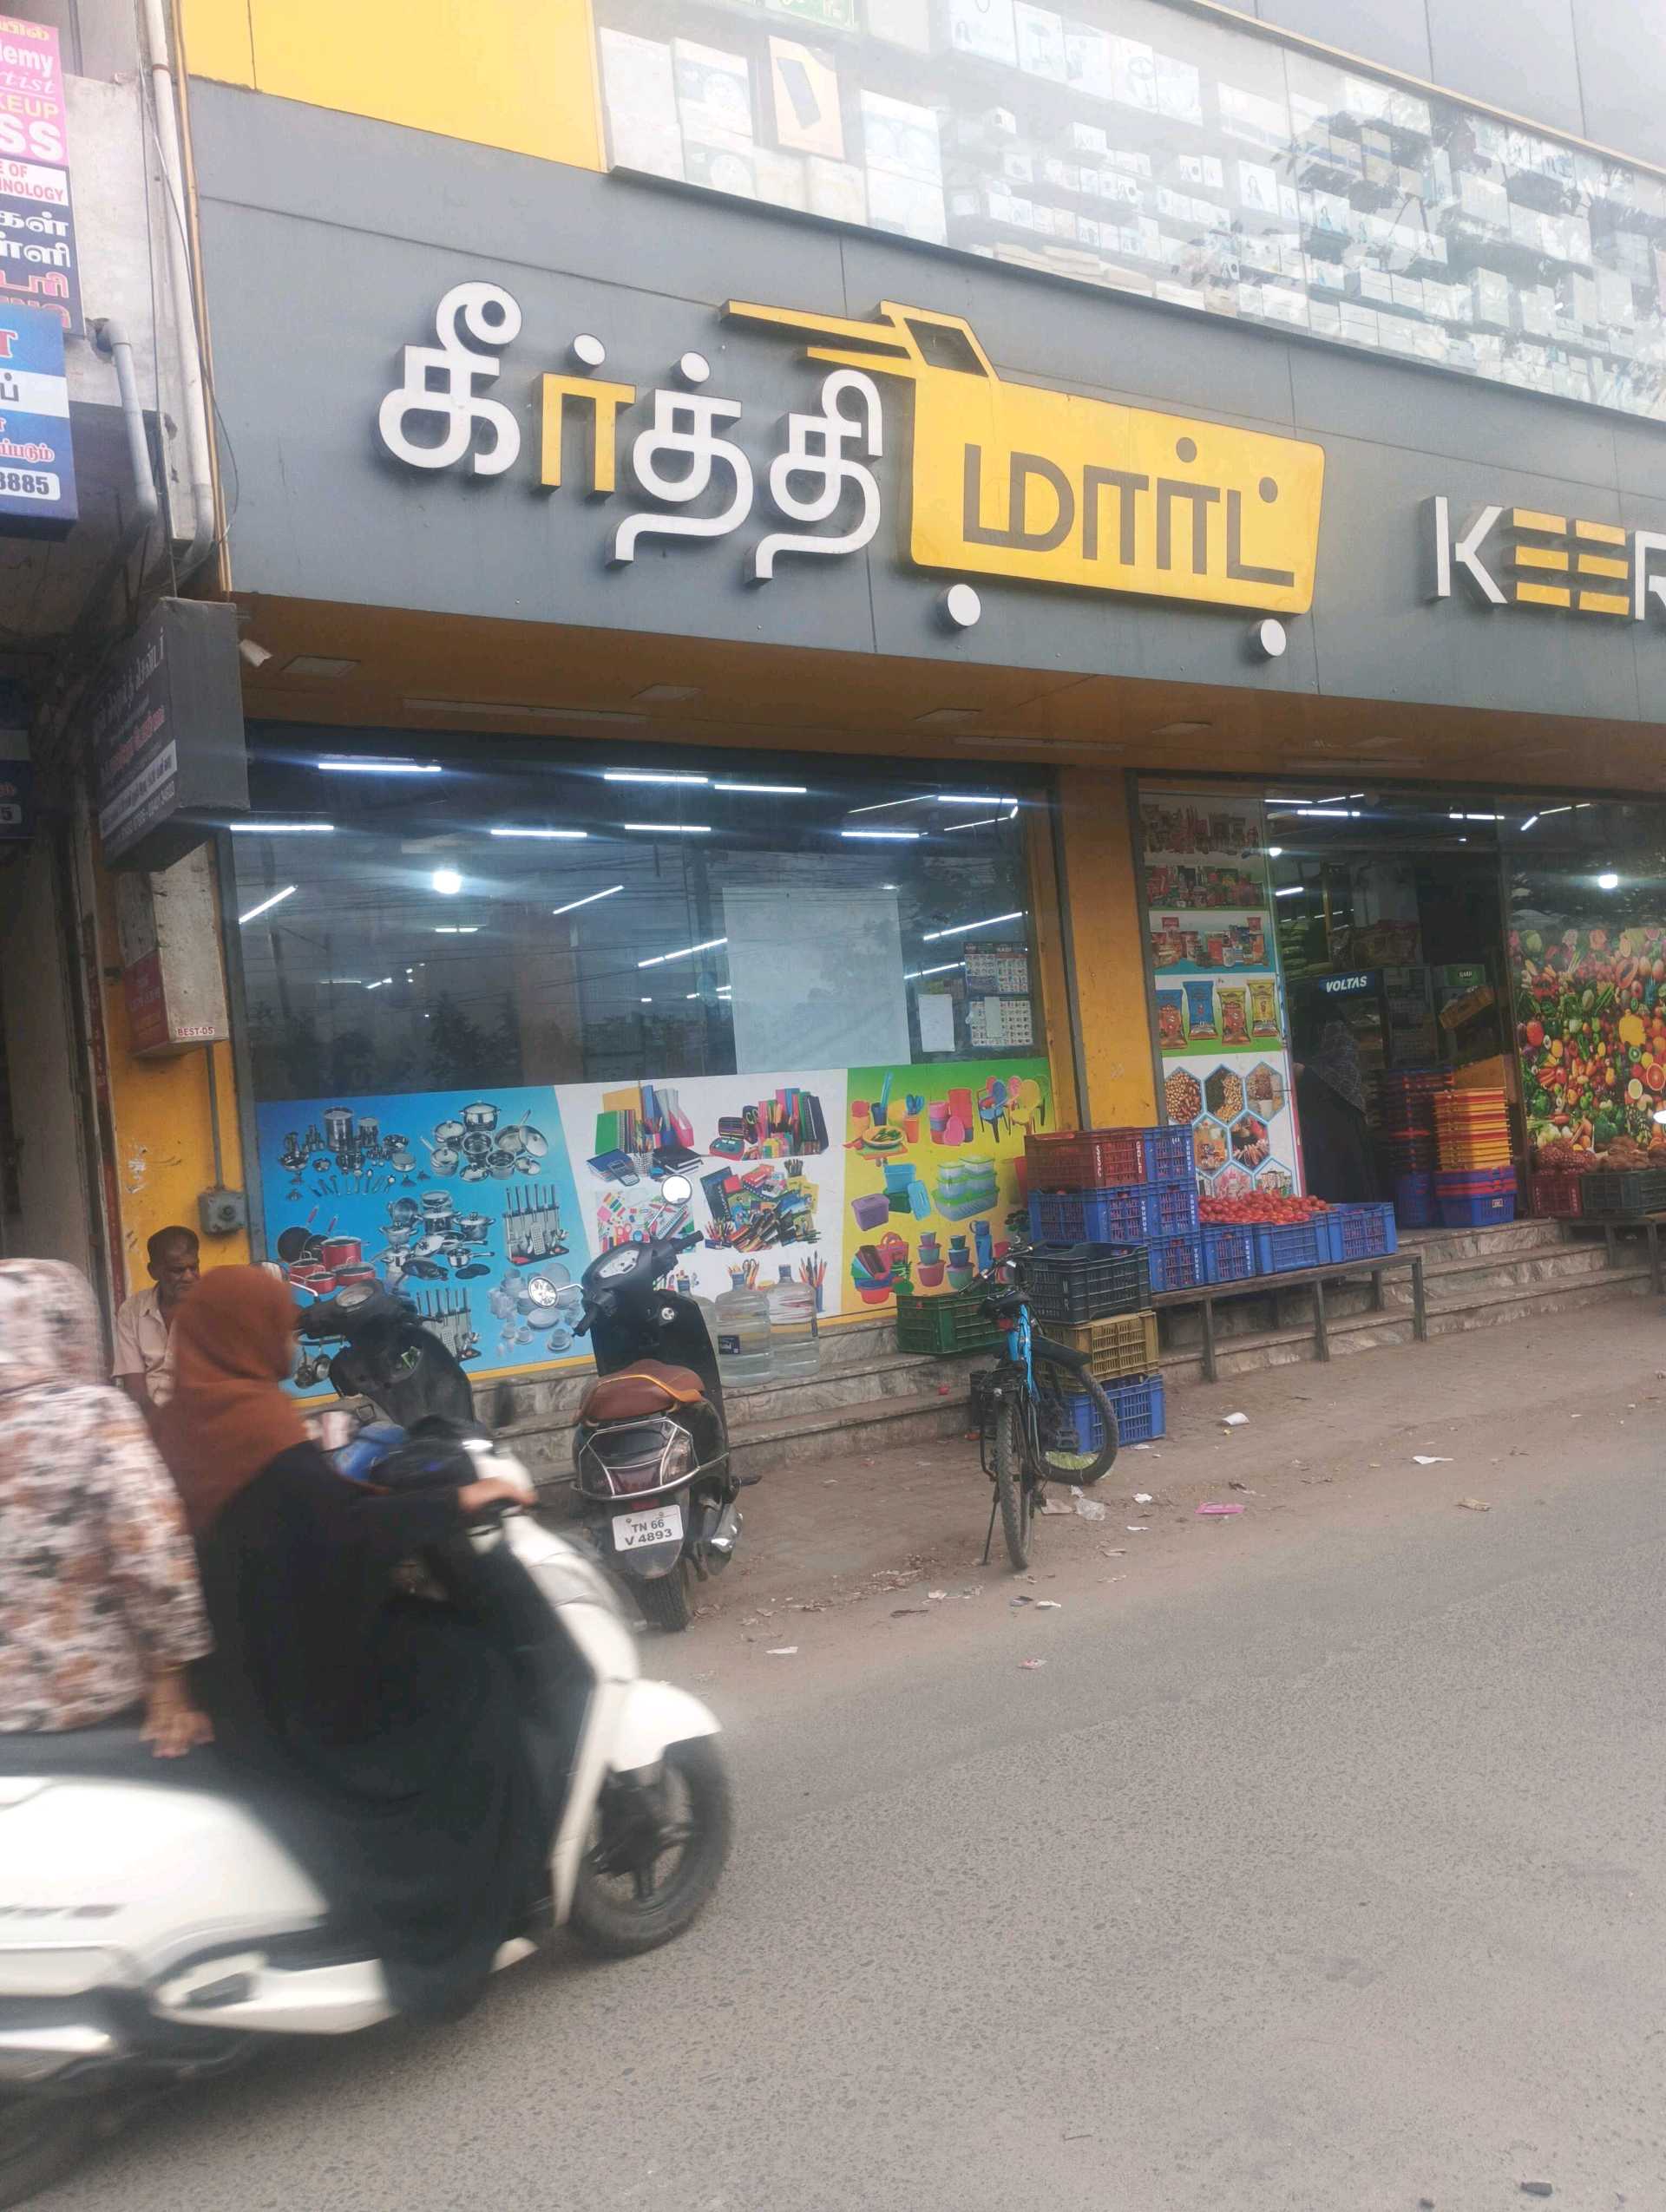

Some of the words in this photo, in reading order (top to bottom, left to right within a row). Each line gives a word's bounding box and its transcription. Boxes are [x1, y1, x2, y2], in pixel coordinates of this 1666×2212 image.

[10, 162, 28, 178] OF
[0, 177, 63, 202] NOLOGY
[379, 281, 883, 579] கீர்த்தி
[963, 436, 1295, 588] மார்ட்
[1326, 975, 1368, 993] VOLTAS
[632, 1522, 647, 1533] TN
[651, 1520, 664, 1529] 66
[638, 1529, 672, 1542] 4893
